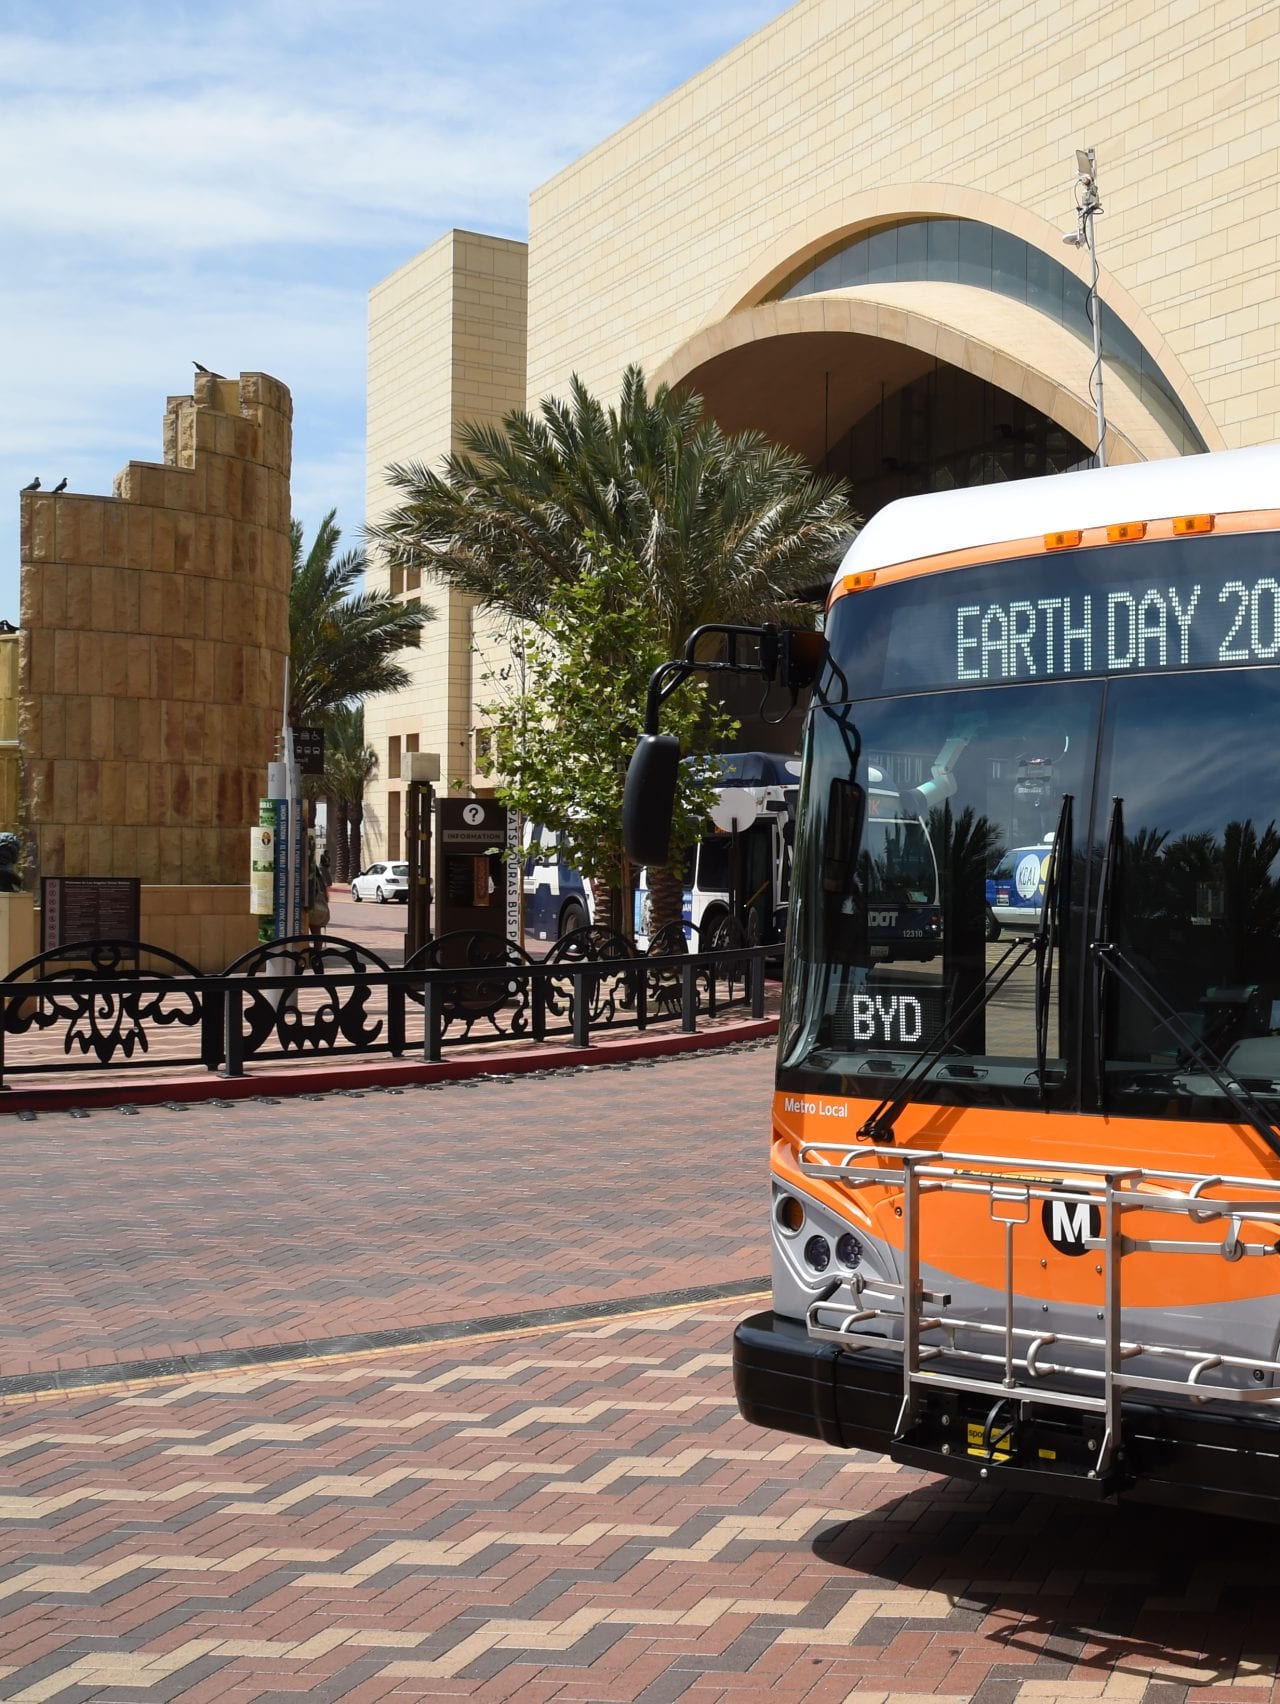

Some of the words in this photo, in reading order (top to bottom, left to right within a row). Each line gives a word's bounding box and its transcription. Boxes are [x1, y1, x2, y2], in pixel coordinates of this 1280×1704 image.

[957, 595, 1092, 680] EARTH
[1107, 584, 1201, 669] DAY
[447, 833, 501, 841] INFORMATION
[1018, 865, 1036, 887] KCAL
[507, 901, 517, 925] BUS
[902, 930, 923, 938] 12310
[853, 994, 922, 1042] BYD
[785, 1097, 816, 1114] Metro
[819, 1101, 848, 1118] Local
[1052, 1199, 1091, 1244] M
